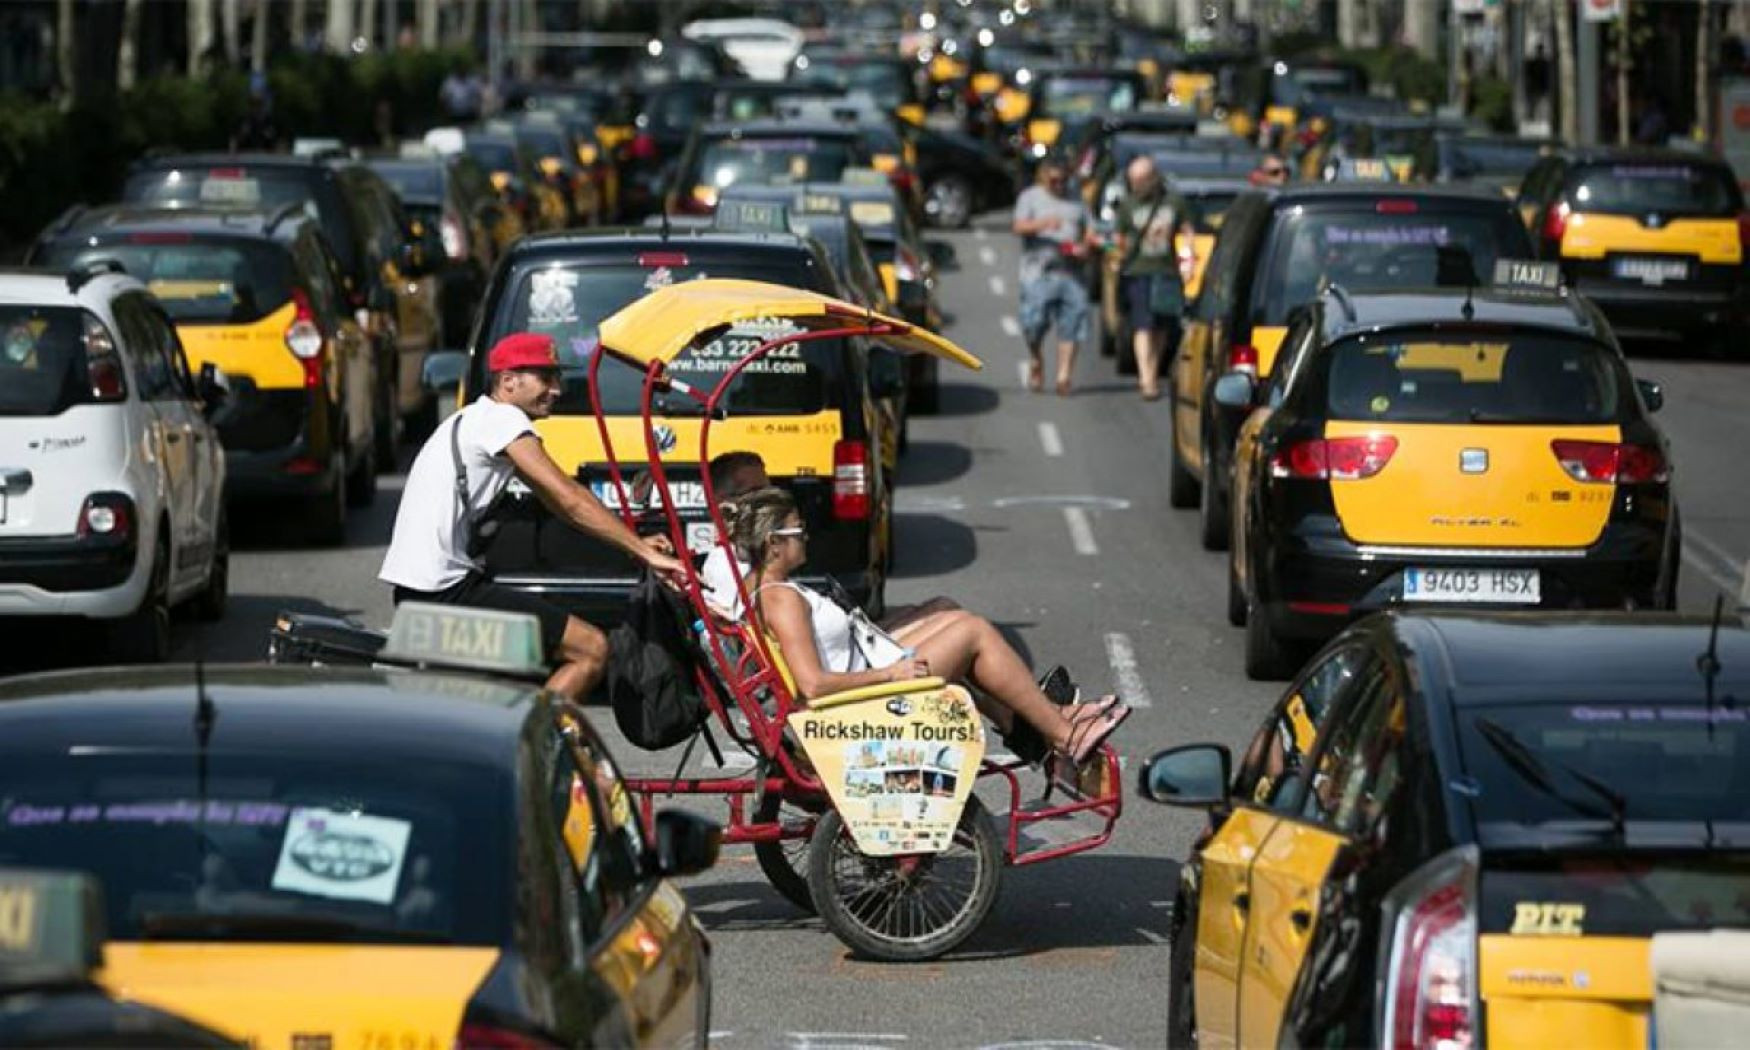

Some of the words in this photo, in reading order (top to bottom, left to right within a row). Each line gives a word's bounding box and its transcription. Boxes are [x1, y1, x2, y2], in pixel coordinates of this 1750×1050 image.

[1511, 264, 1544, 281] TAXI
[1424, 570, 1479, 593] 9403
[1492, 571, 1533, 594] HSX
[441, 616, 505, 658] TAXI
[804, 720, 904, 739] Rickshaw
[911, 722, 976, 741] Tours!
